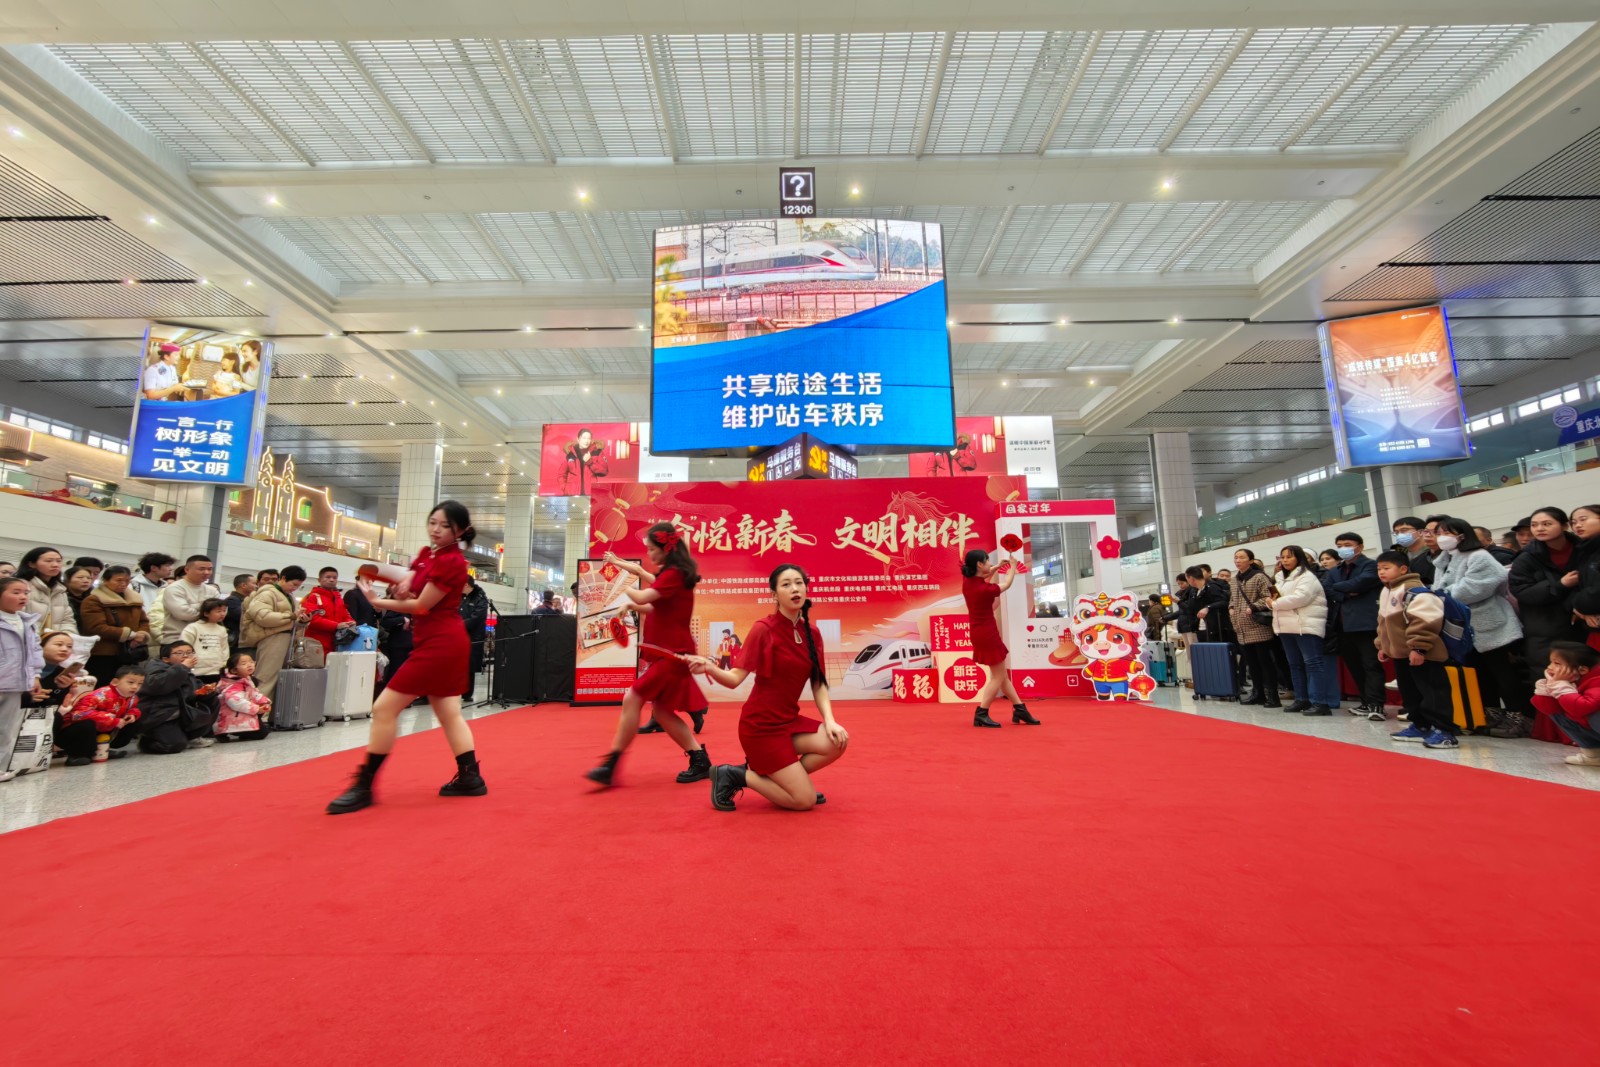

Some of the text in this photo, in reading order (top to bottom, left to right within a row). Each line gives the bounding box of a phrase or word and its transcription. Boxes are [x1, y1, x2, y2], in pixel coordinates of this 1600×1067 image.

[783, 205, 814, 215] 12306
[722, 372, 882, 399] 共享旅途生活
[157, 416, 234, 431] 一言一行
[722, 402, 884, 429] 维护站车秩序
[155, 426, 233, 446] 树形象
[152, 446, 230, 460] 一举一动
[150, 458, 230, 476] 见文明
[1005, 502, 1051, 514] 回家过年
[831, 512, 980, 564] 文明相伴
[953, 665, 977, 677] 新年
[894, 673, 934, 699] 福 福
[954, 679, 978, 692] 快乐
